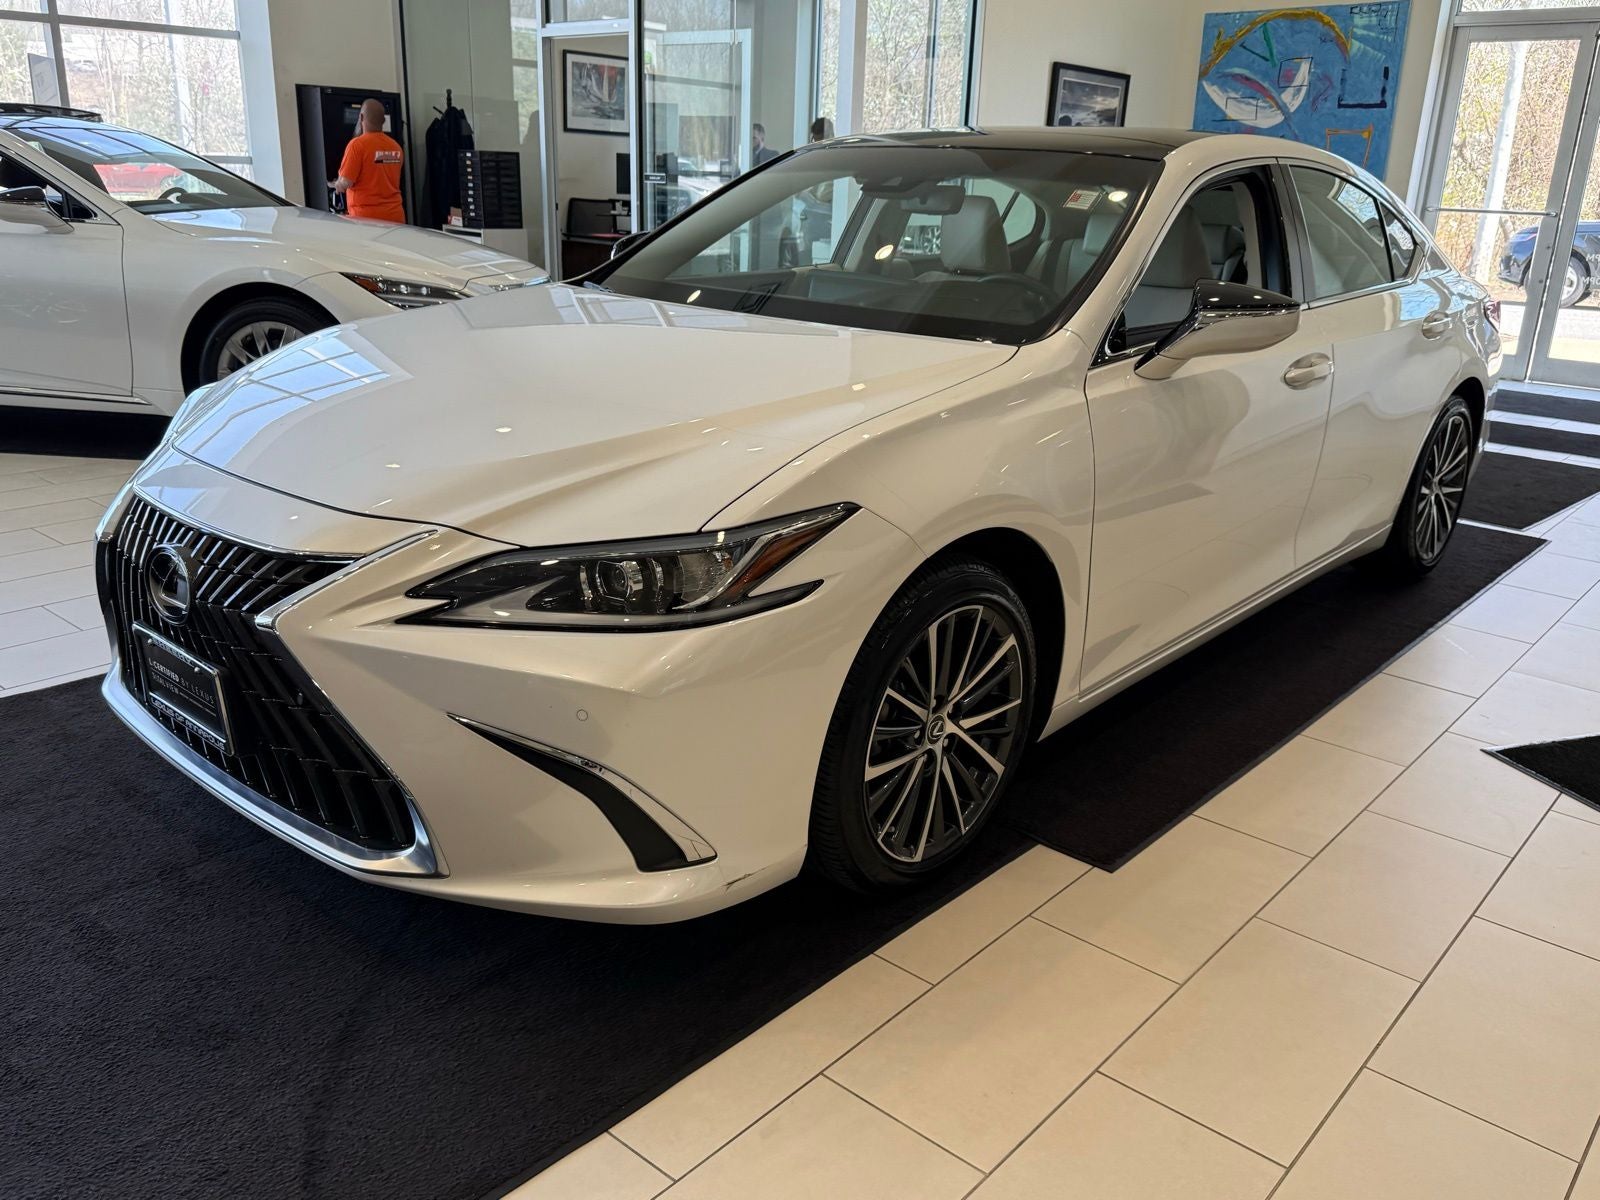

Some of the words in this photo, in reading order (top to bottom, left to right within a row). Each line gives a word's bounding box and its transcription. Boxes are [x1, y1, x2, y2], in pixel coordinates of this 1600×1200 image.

[191, 684, 215, 704] LEXUS
[151, 697, 175, 718] LEXUS
[175, 712, 185, 722] OF
